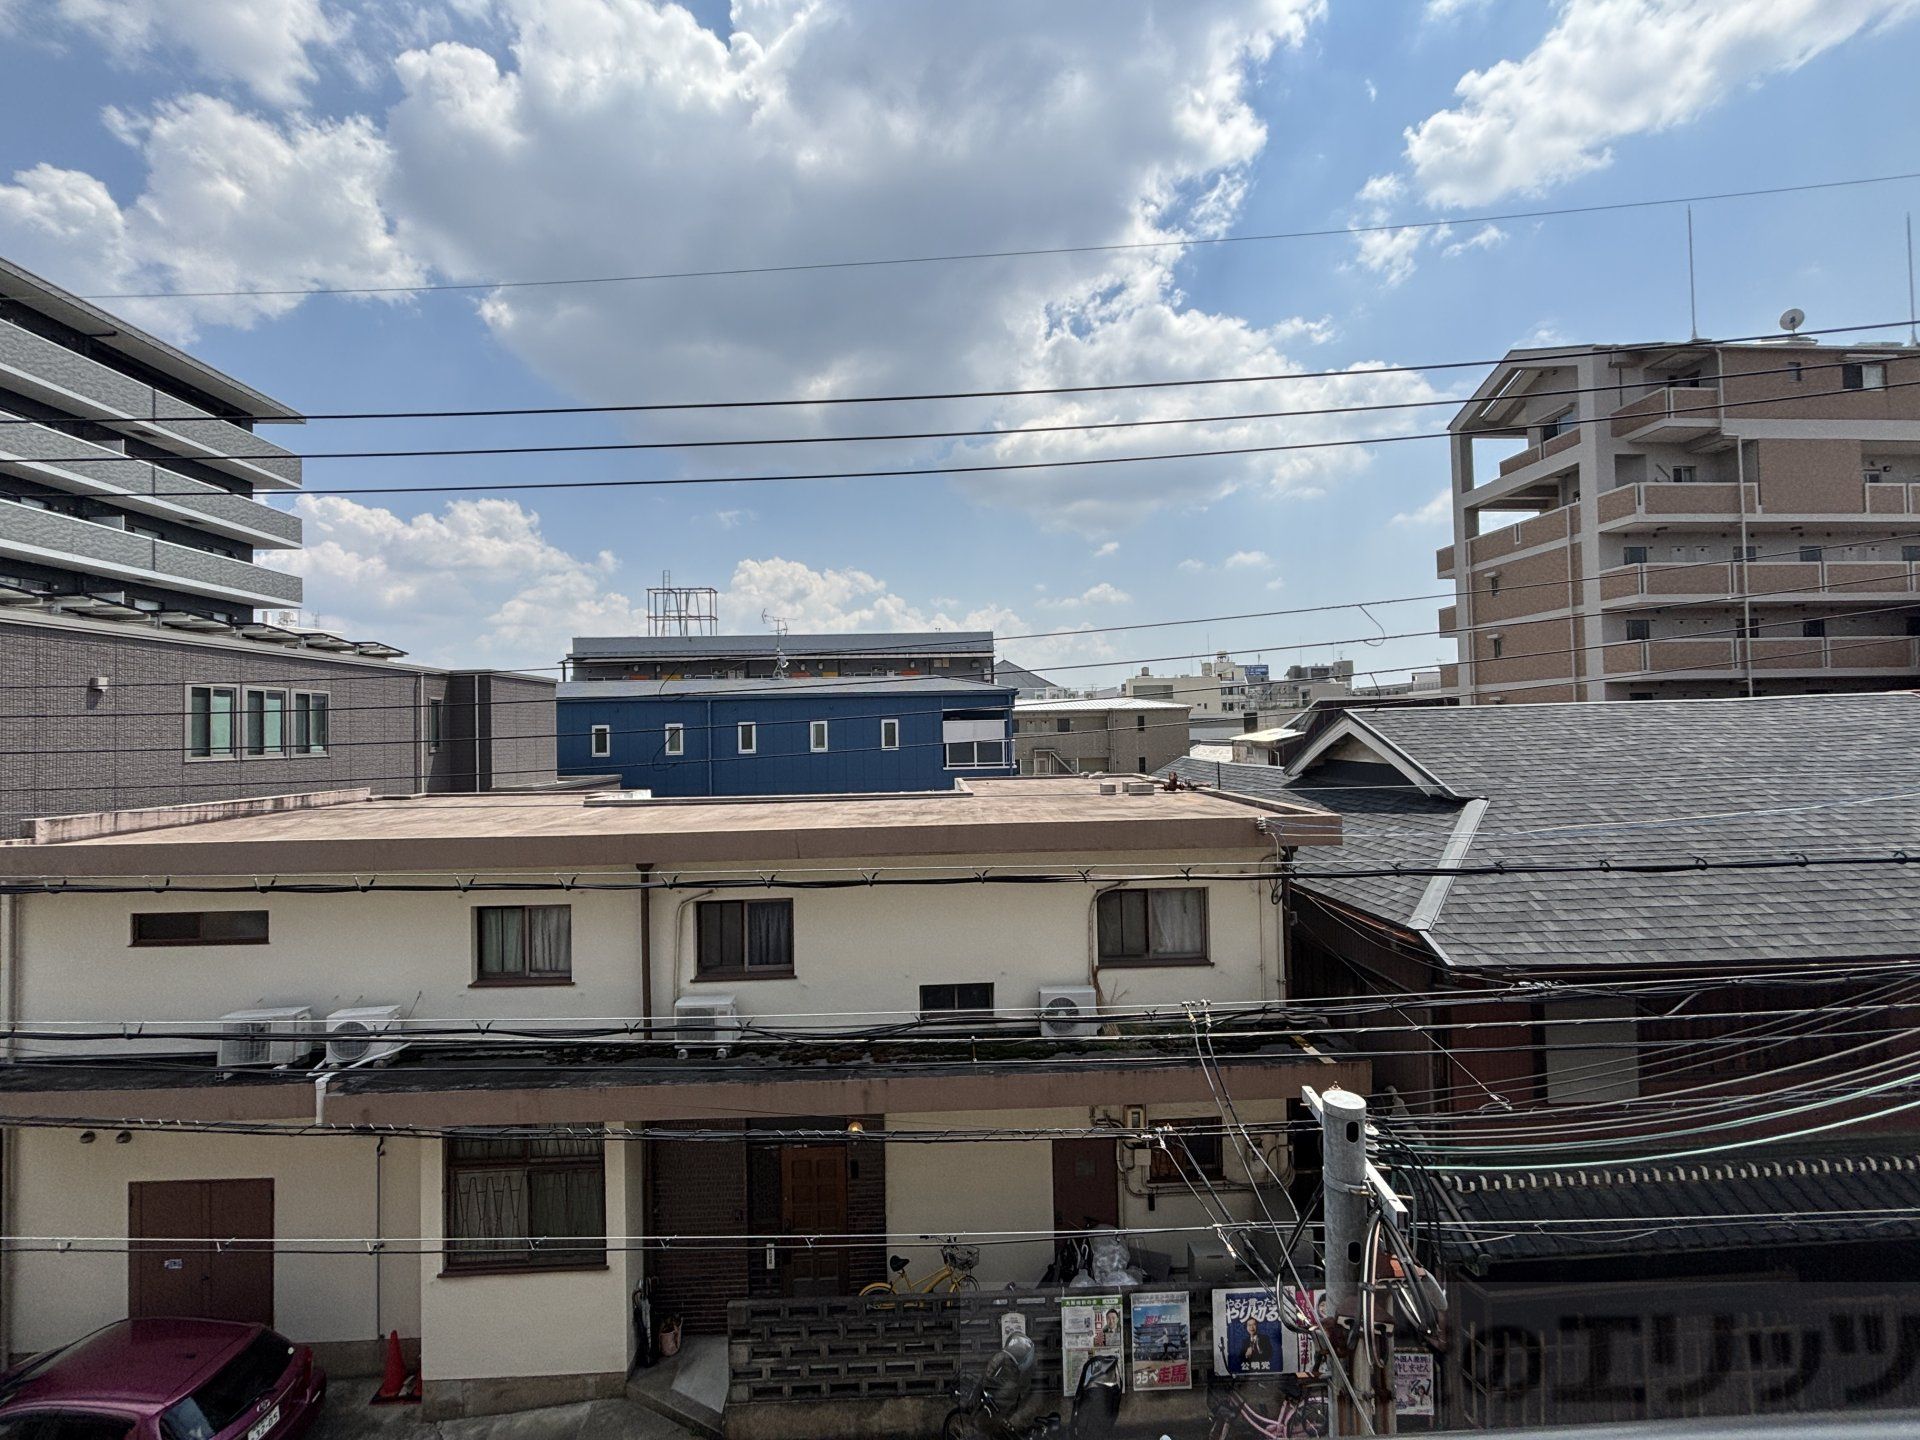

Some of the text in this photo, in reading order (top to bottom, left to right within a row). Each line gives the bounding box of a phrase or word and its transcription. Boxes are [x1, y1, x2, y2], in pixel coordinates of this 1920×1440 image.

[1241, 1361, 1271, 1370] 公明党
[1136, 1363, 1187, 1384] うらべ走馬
